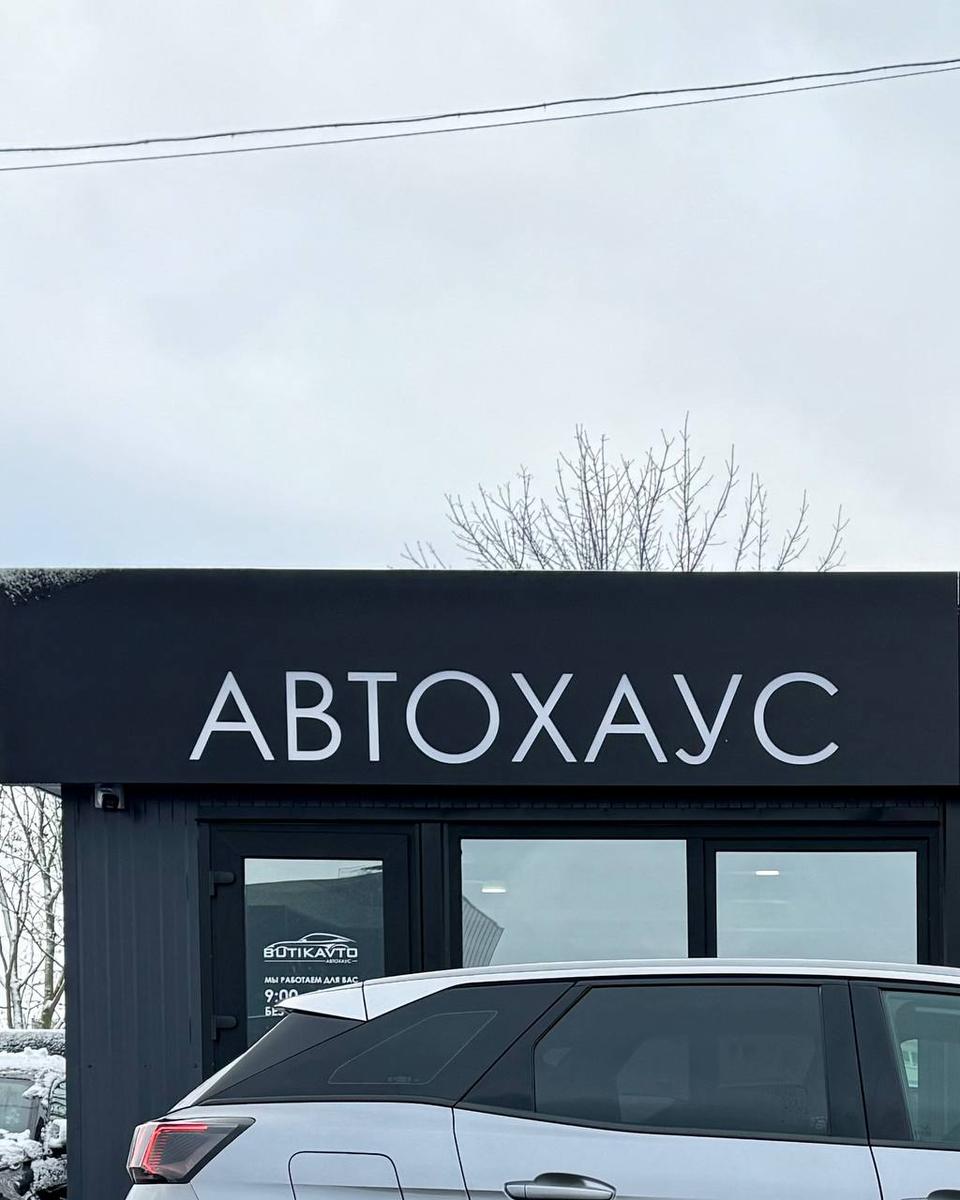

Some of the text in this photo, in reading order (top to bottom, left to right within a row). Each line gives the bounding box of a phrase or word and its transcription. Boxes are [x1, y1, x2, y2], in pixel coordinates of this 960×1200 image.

[189, 671, 839, 765] АВТОХАУС
[263, 947, 358, 958] BUTIKAVTO
[264, 976, 279, 984] МЫ
[281, 976, 322, 984] РАБОТАЕМ
[323, 976, 340, 985] ДЛЯ
